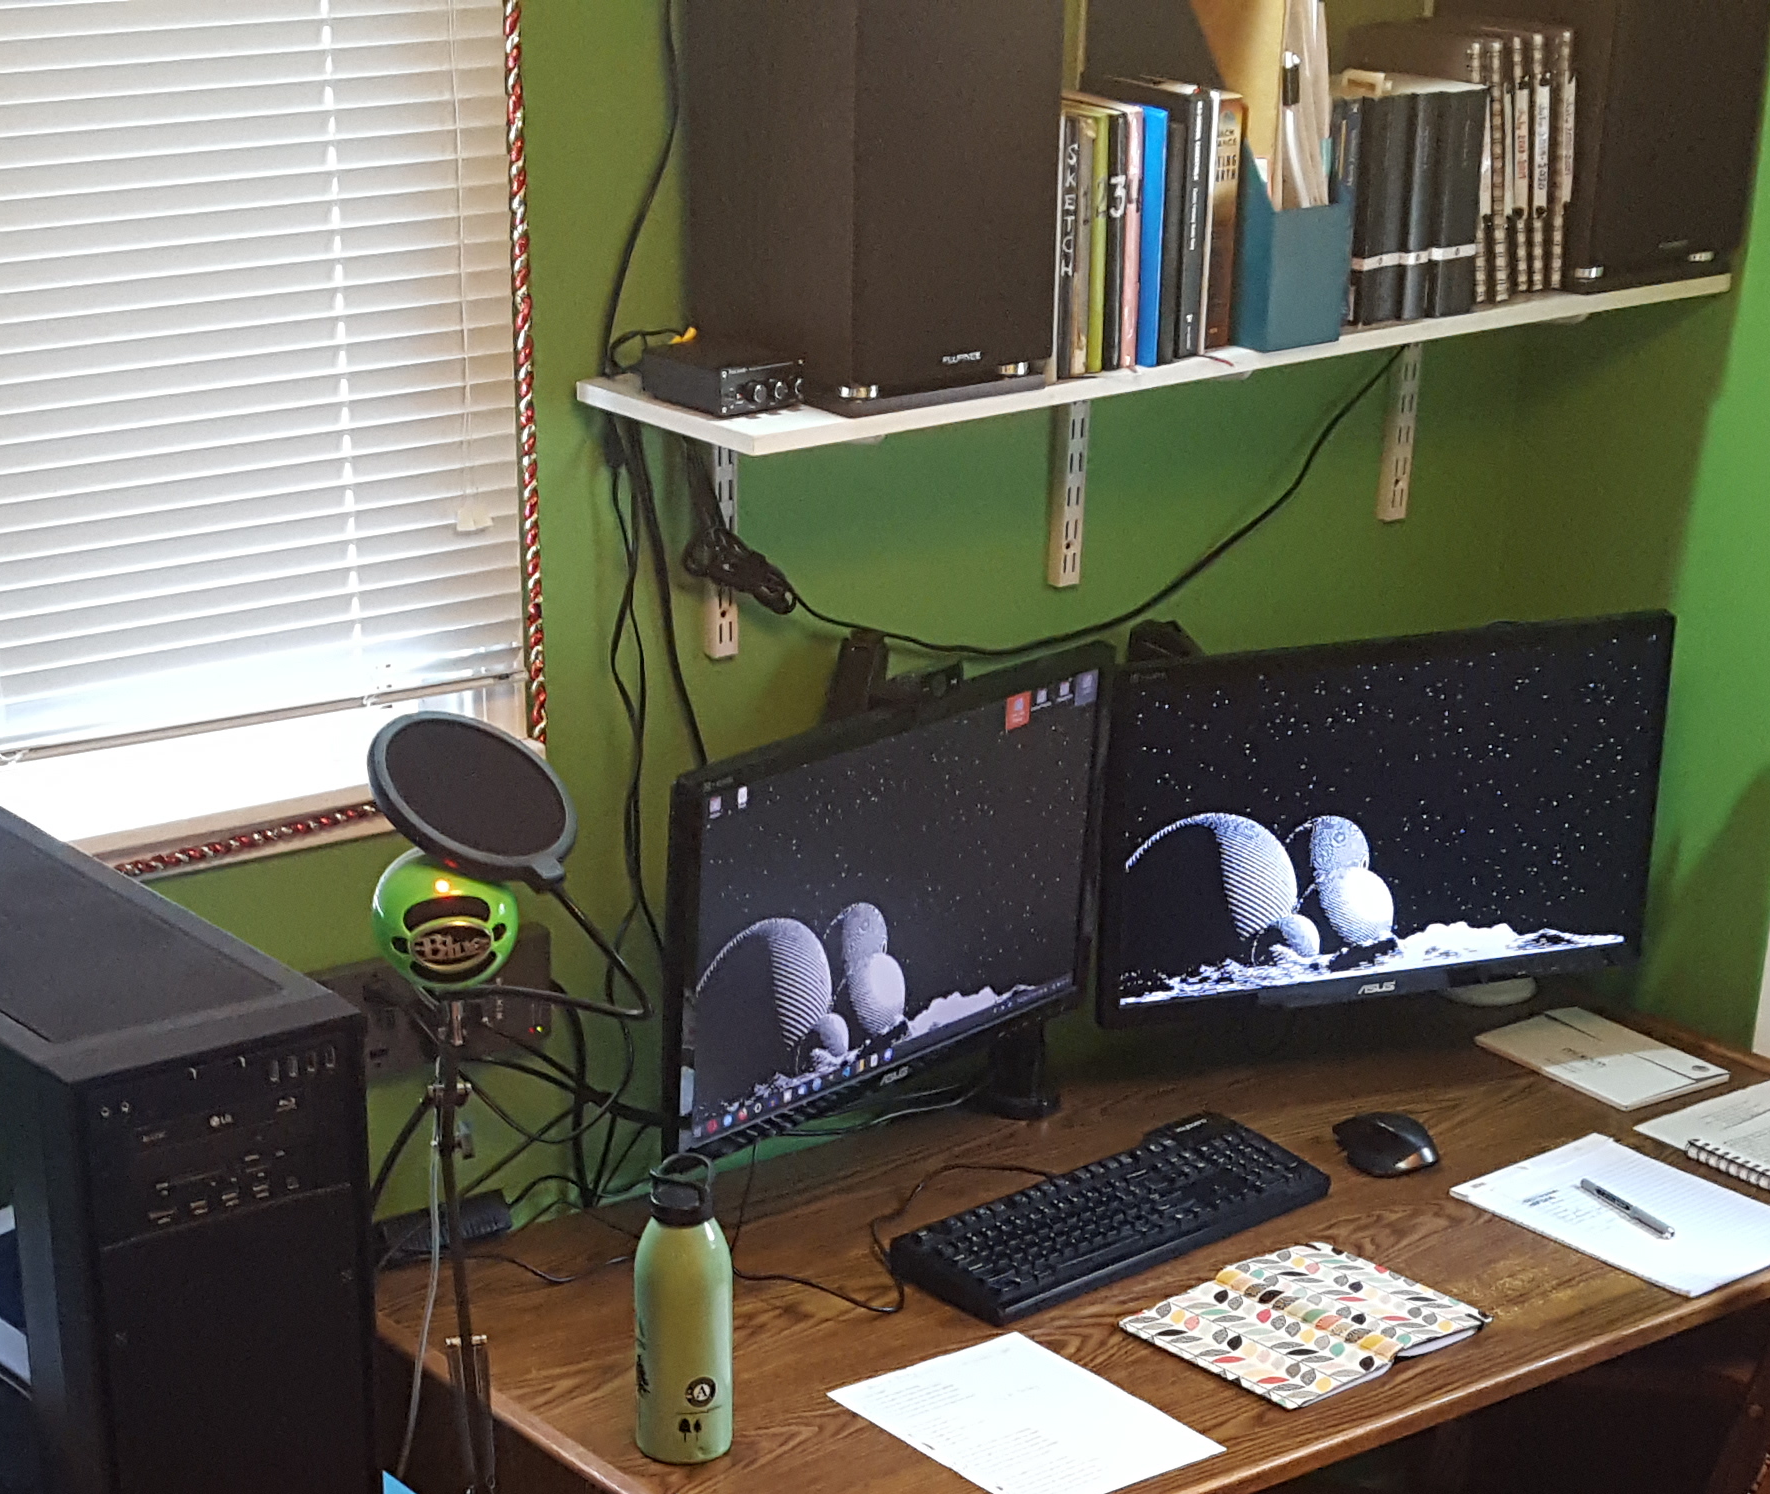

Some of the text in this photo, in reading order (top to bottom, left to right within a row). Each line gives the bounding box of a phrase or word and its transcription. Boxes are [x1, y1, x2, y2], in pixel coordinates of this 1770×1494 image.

[1109, 174, 1126, 218] 3
[1061, 143, 1079, 277] SKETCH
[413, 933, 492, 960] Blue
[1357, 979, 1397, 995] ASUS
[879, 1065, 910, 1087] ASUS
